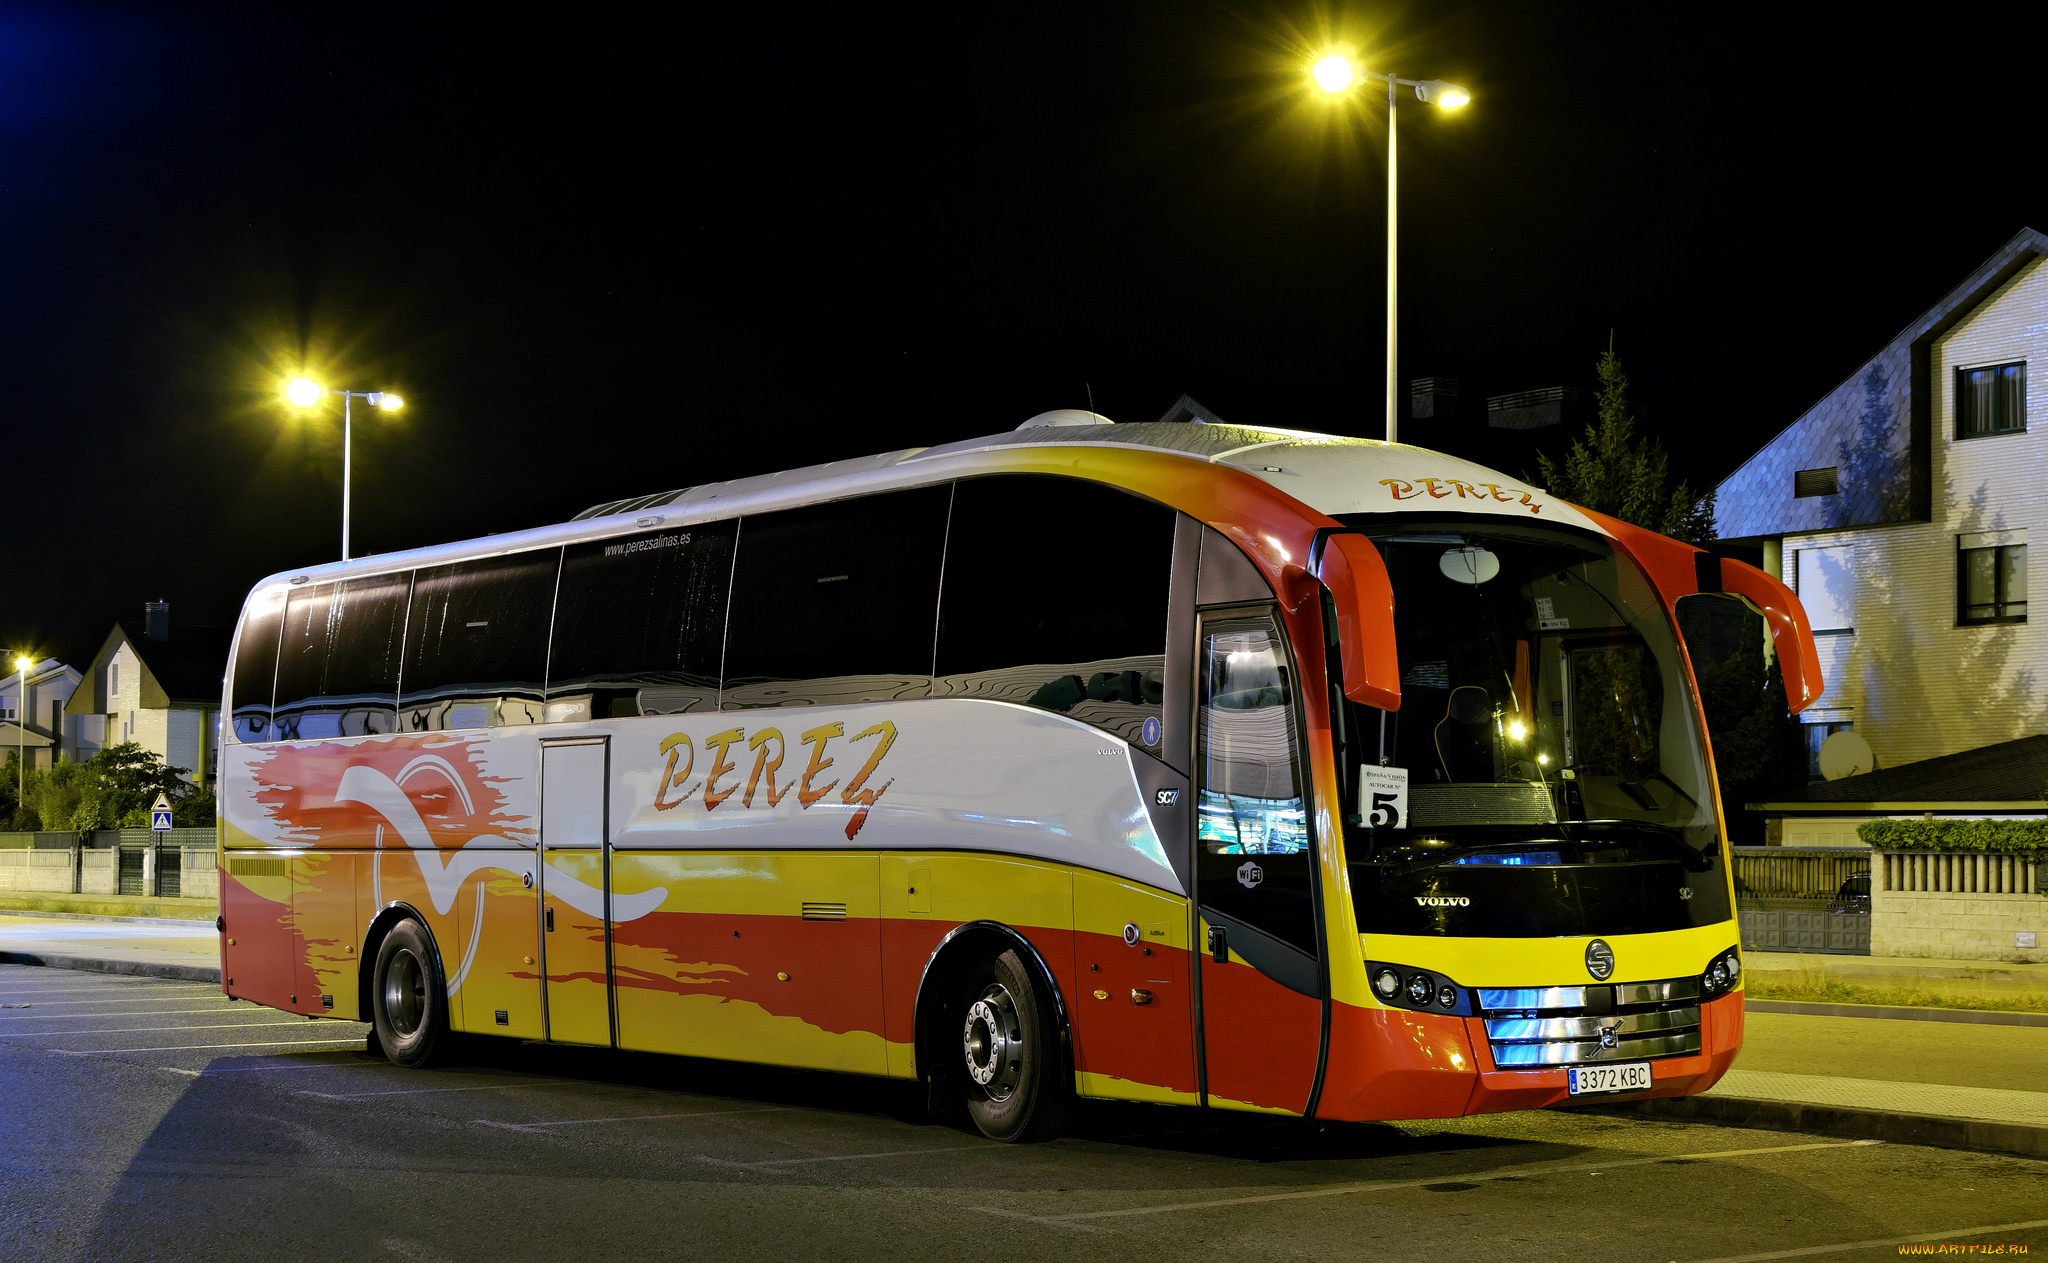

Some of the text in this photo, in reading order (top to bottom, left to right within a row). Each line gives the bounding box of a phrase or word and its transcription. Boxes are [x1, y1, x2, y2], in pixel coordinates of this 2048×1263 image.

[1378, 477, 1543, 514] PEREZ
[604, 532, 692, 557] www.perezsalinas.es
[1097, 748, 1123, 756] VOLVO
[654, 720, 899, 841] PEREZ
[1156, 789, 1179, 806] SC7
[1369, 792, 1399, 829] 5
[1414, 896, 1470, 908] VOLVO
[1580, 1067, 1646, 1090] 3372 KBC
